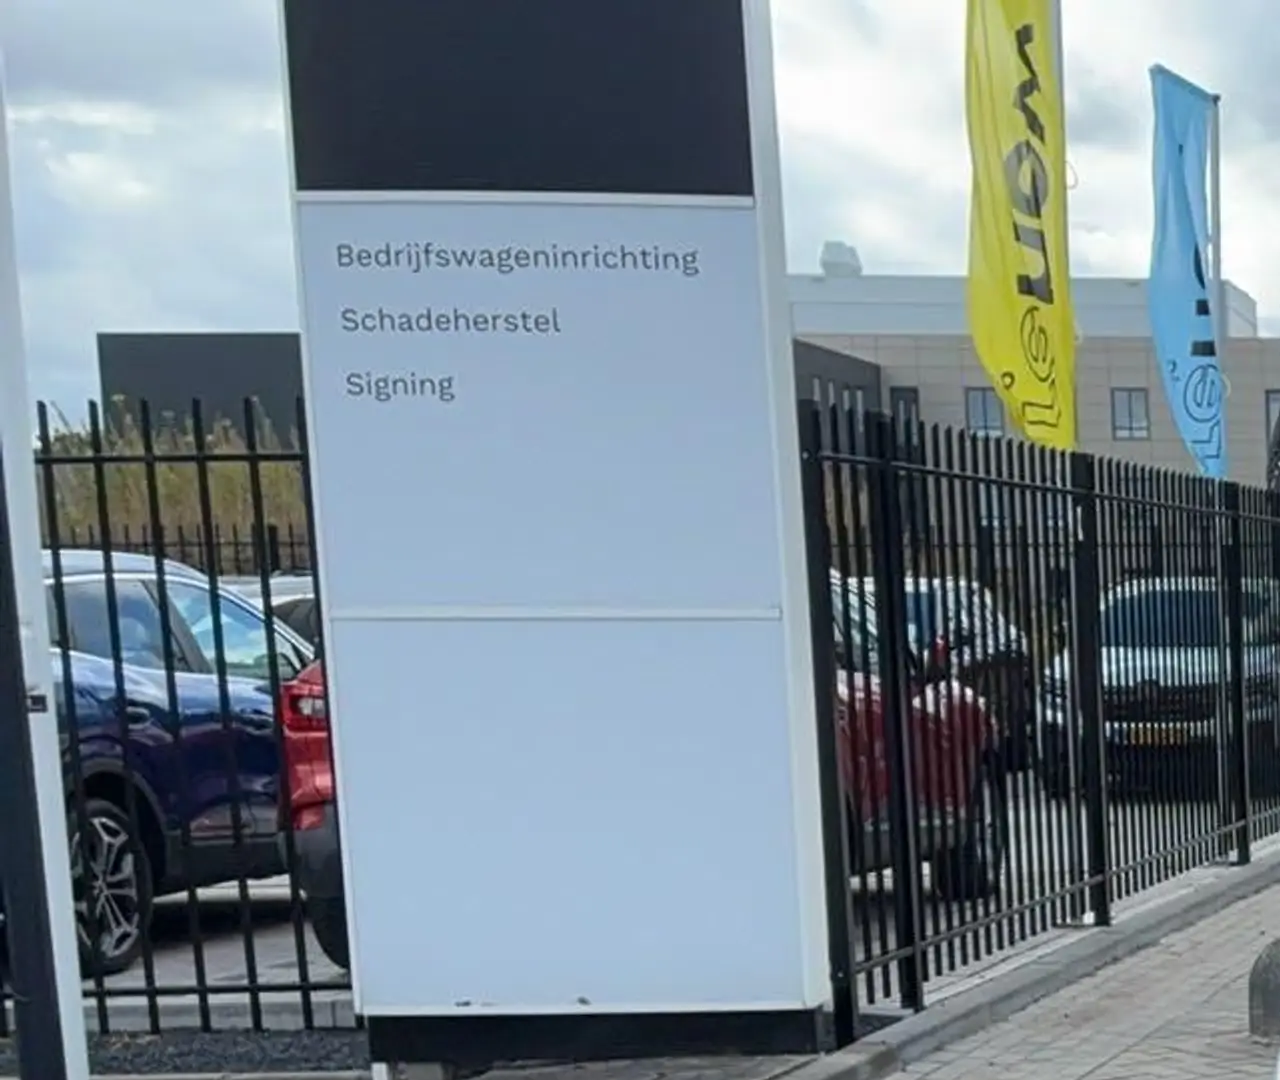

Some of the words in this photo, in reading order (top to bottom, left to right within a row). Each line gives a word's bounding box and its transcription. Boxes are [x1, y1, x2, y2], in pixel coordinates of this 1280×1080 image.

[336, 243, 700, 276] Bedrijfswageninrichting
[340, 308, 561, 333] Schadeherstel
[345, 371, 455, 401] Signing
